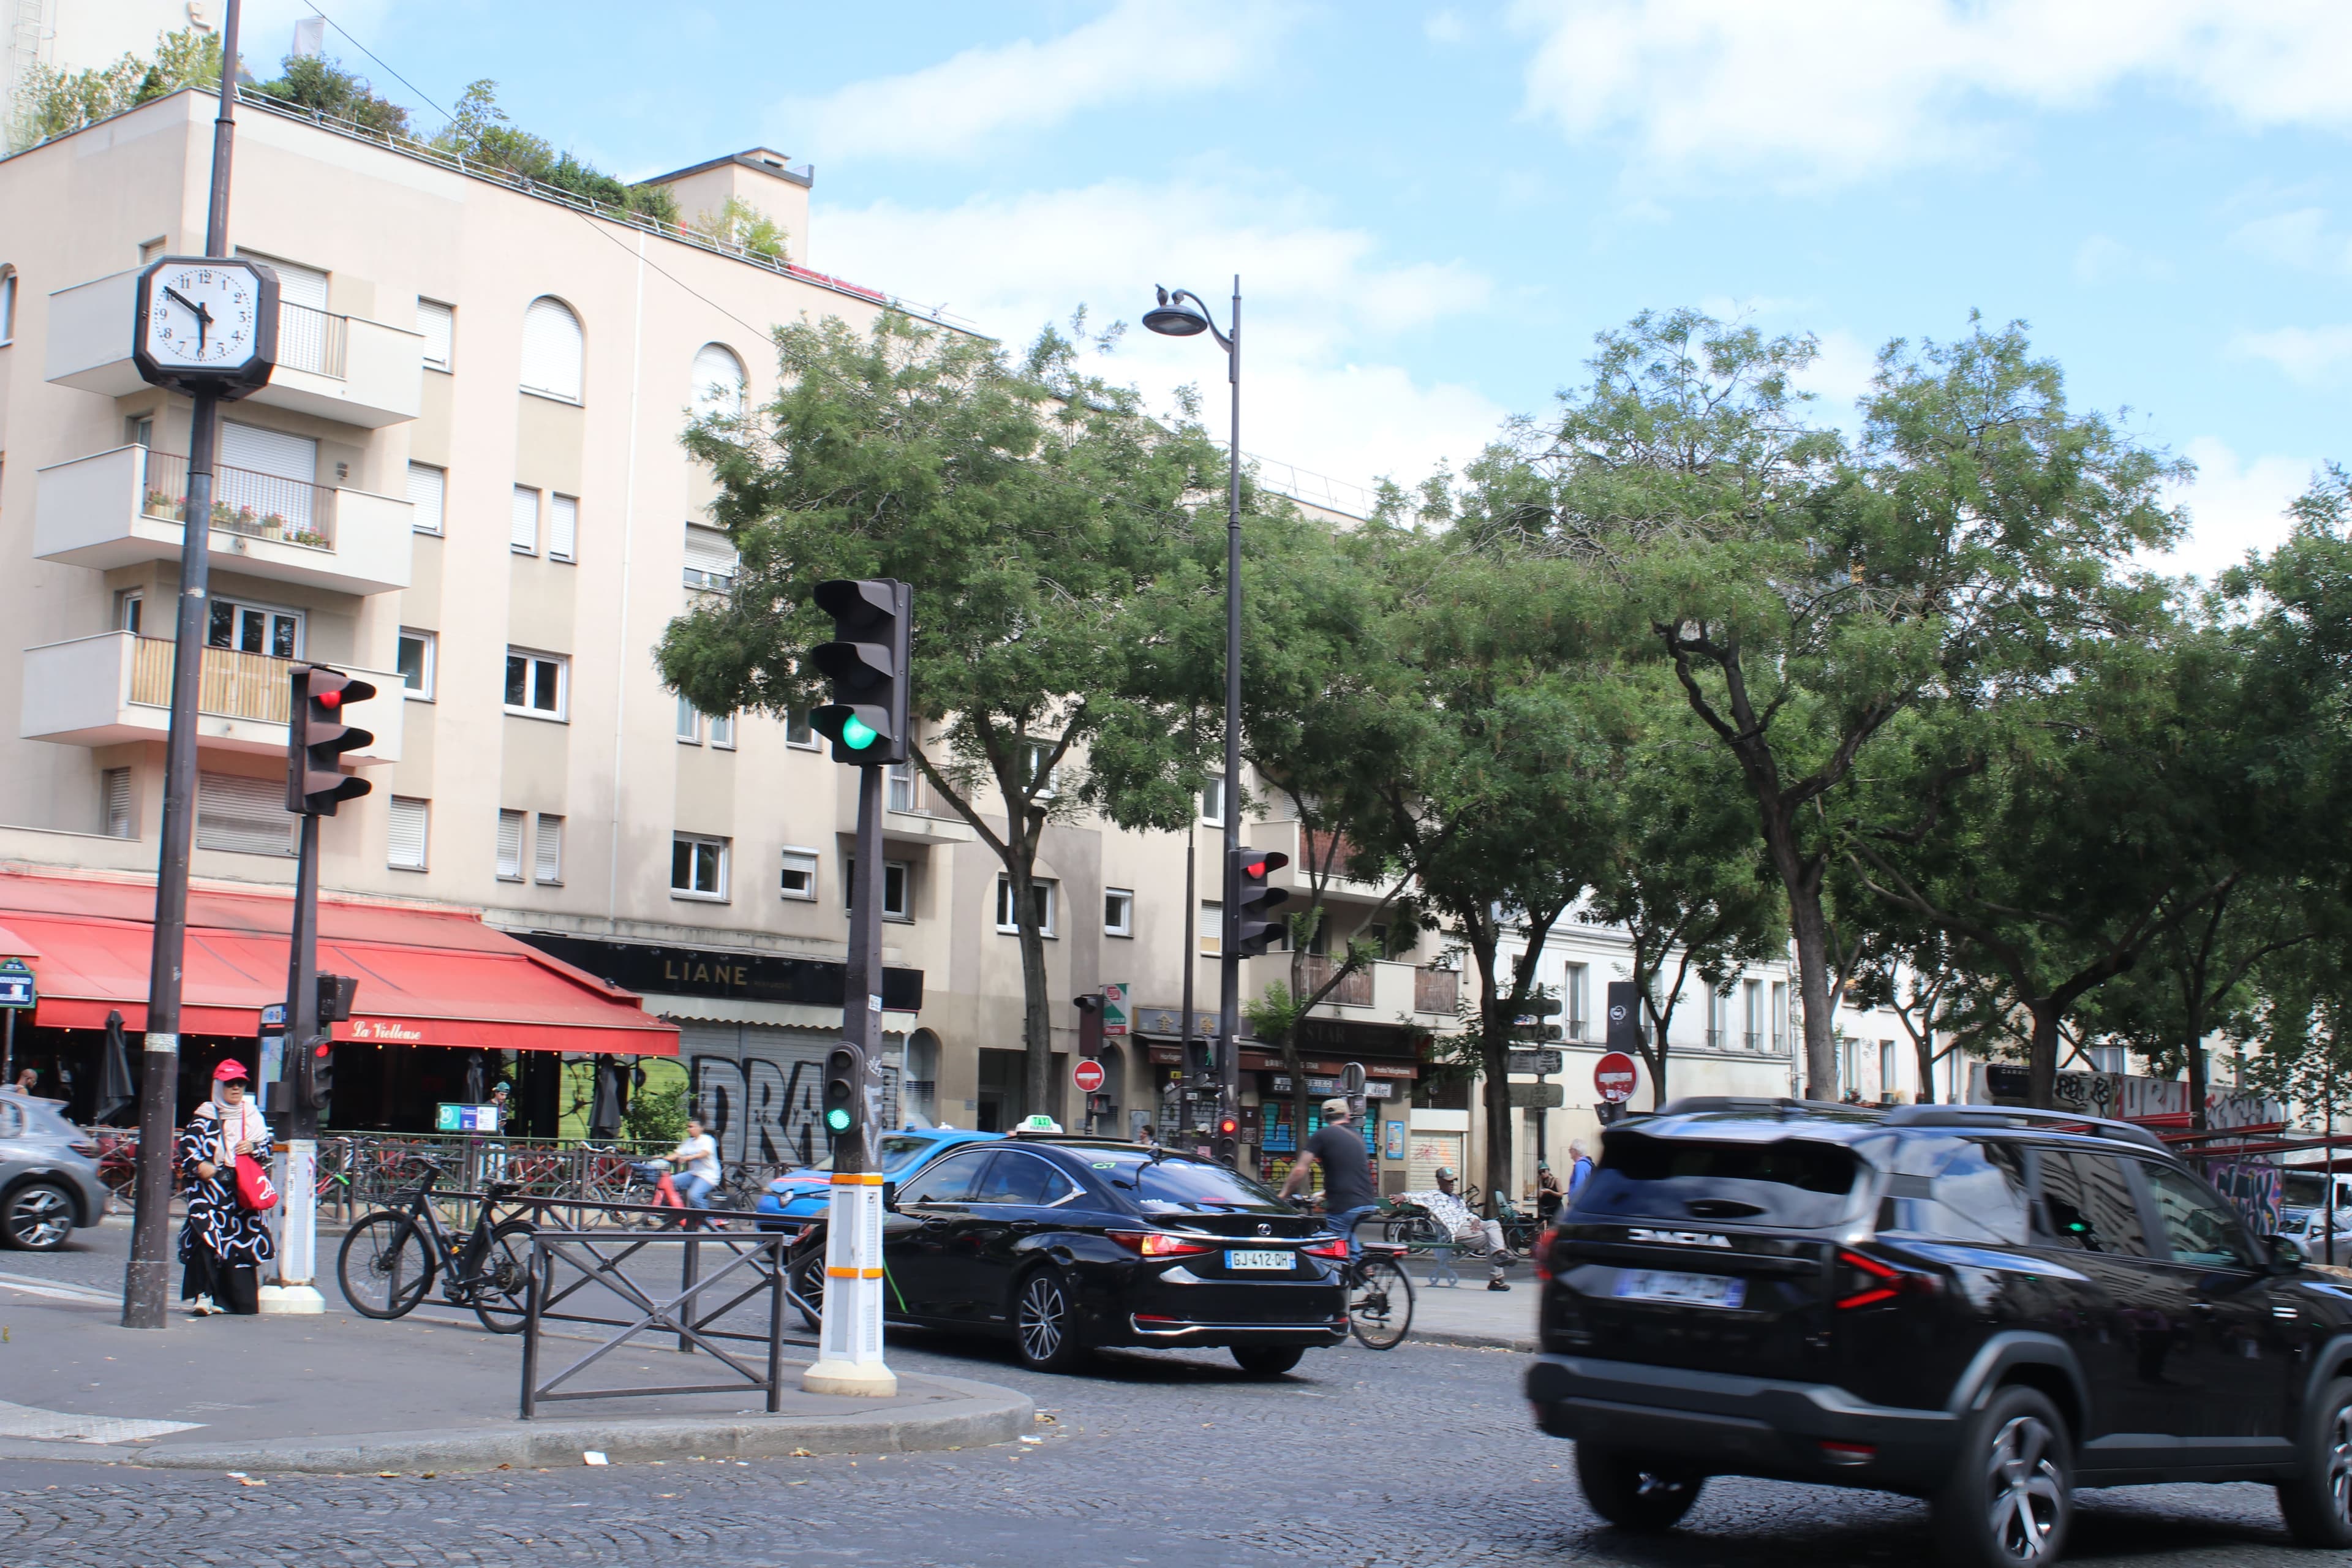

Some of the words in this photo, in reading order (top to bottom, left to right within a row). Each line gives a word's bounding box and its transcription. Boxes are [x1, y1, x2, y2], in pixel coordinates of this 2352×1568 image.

[179, 278, 190, 289] 11
[198, 272, 211, 284] 12
[222, 279, 227, 290] 1
[233, 292, 243, 304] 2
[159, 308, 167, 320] 9
[238, 311, 246, 323] 3
[163, 327, 172, 339] 8
[231, 330, 241, 341] 4
[178, 341, 186, 352] 7
[216, 342, 225, 354] 5
[197, 347, 205, 359] 6
[665, 960, 748, 986] LIANE
[352, 1020, 372, 1038] La
[372, 1022, 421, 1040] Vielleuse
